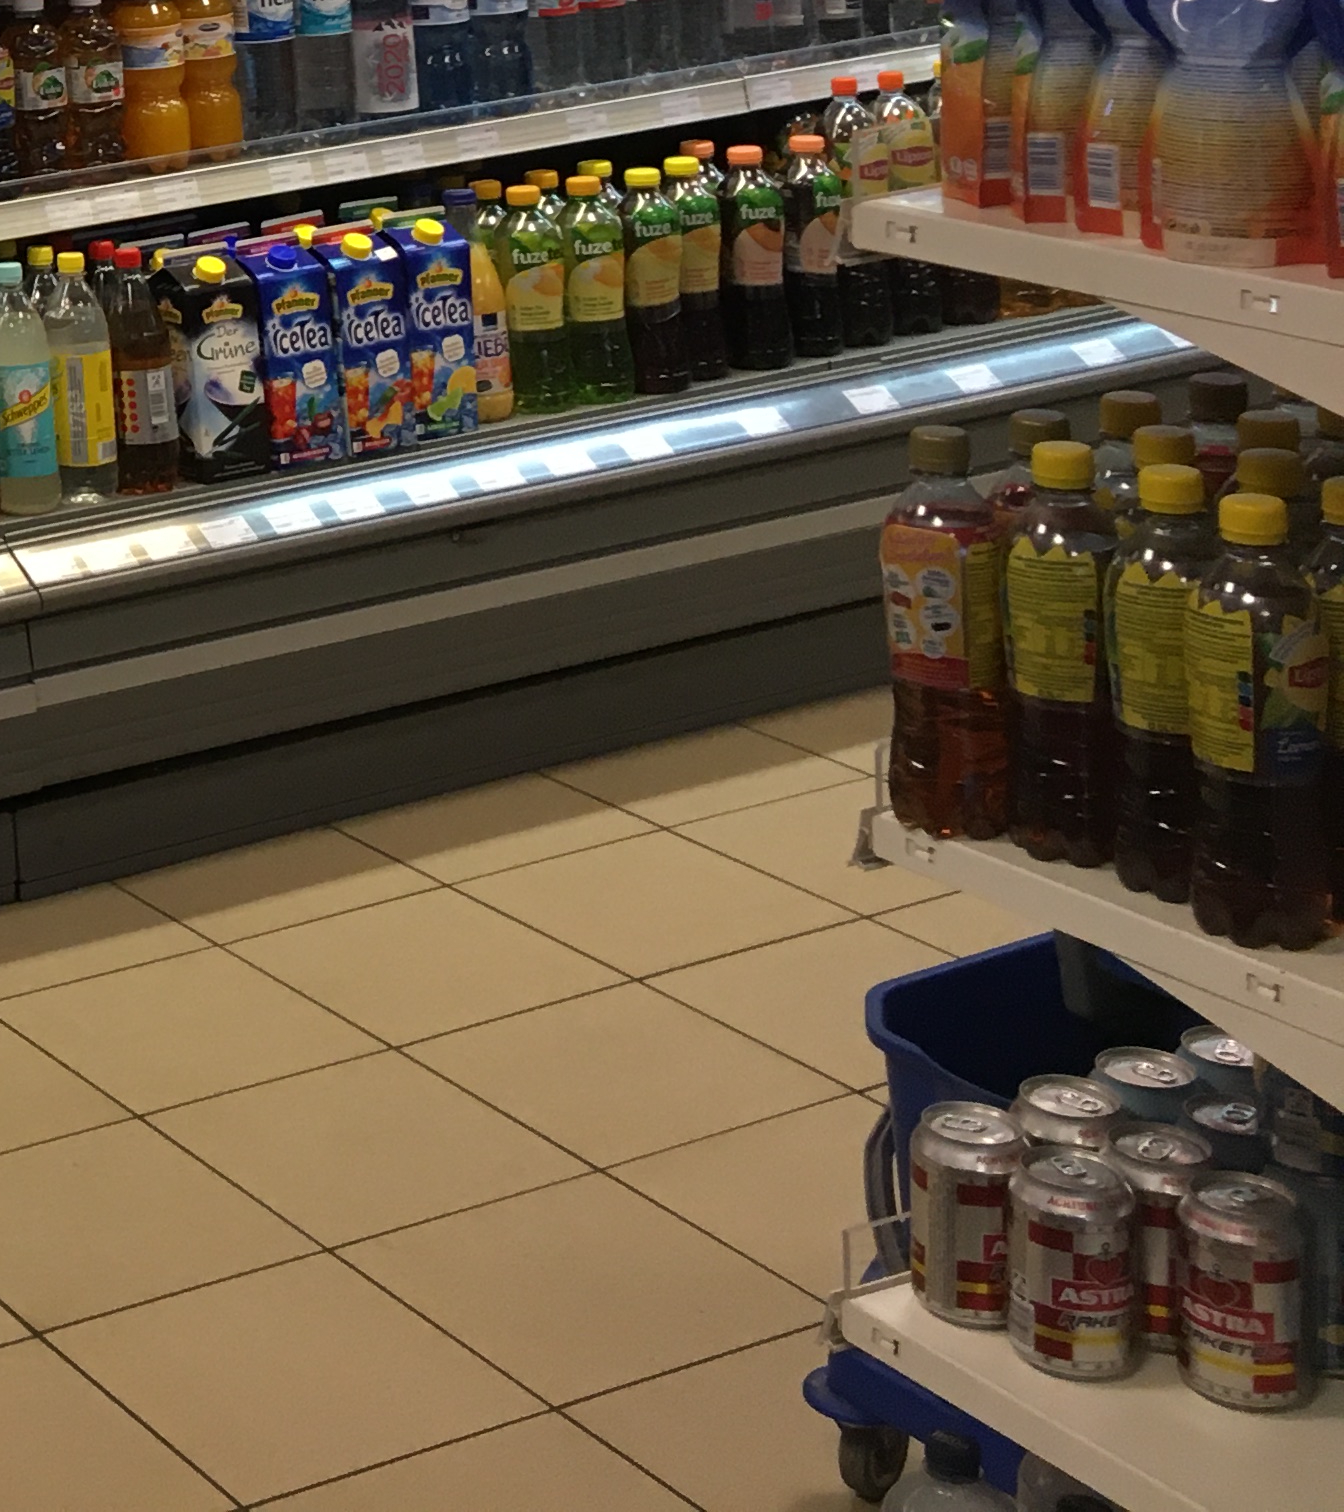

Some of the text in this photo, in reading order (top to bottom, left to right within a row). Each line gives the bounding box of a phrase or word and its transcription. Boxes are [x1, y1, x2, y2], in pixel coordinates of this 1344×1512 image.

[741, 204, 776, 221] fuze
[635, 220, 671, 238] fuze
[215, 325, 238, 339] Der
[197, 336, 256, 361] Grüne
[1, 390, 49, 425] Schweppes
[1181, 1295, 1266, 1334] ASTRA
